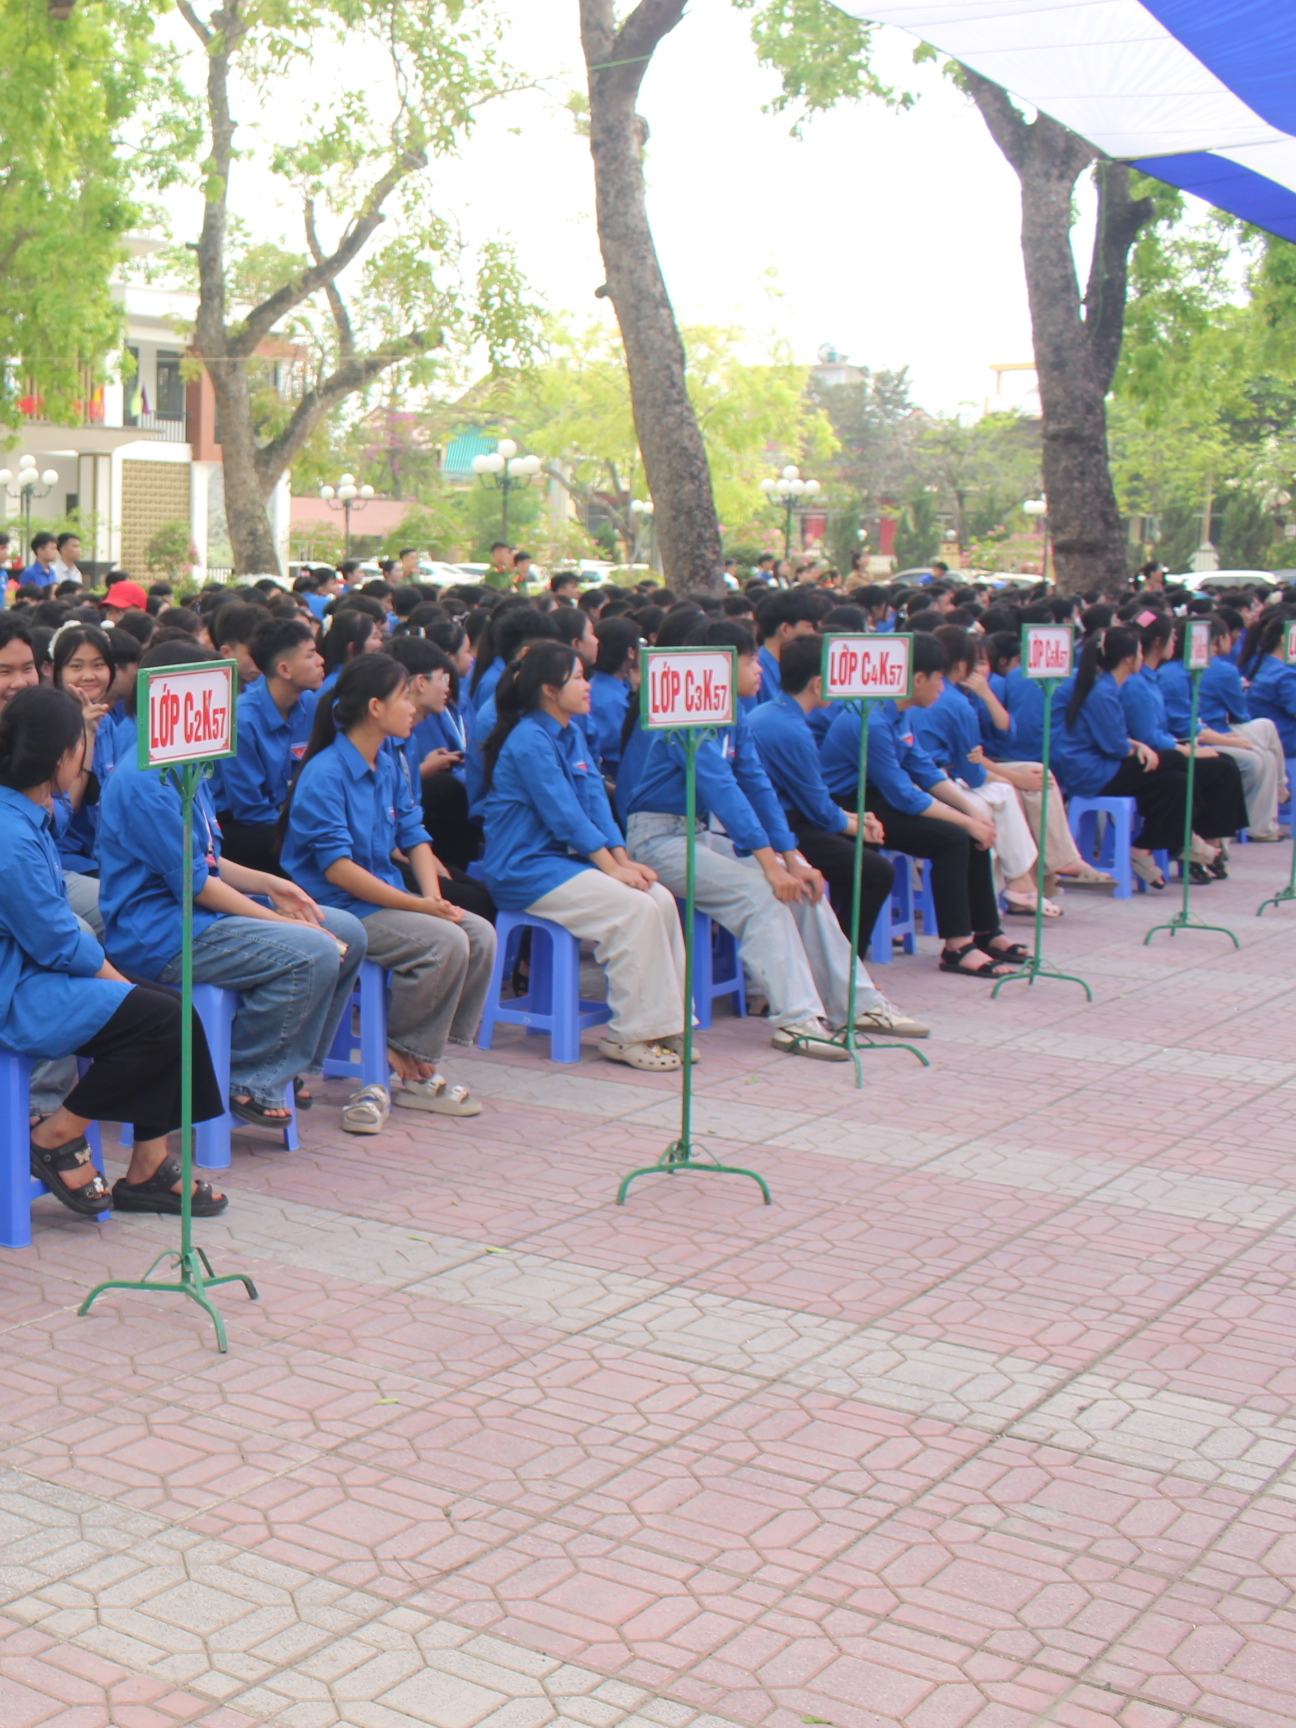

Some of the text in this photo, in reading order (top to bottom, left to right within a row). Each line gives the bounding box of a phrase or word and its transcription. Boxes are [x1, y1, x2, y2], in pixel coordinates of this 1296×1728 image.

[651, 661, 728, 714] LỚP C3K57
[830, 643, 903, 686] LỚP C4K57
[150, 683, 227, 749] LỚP C2K57
